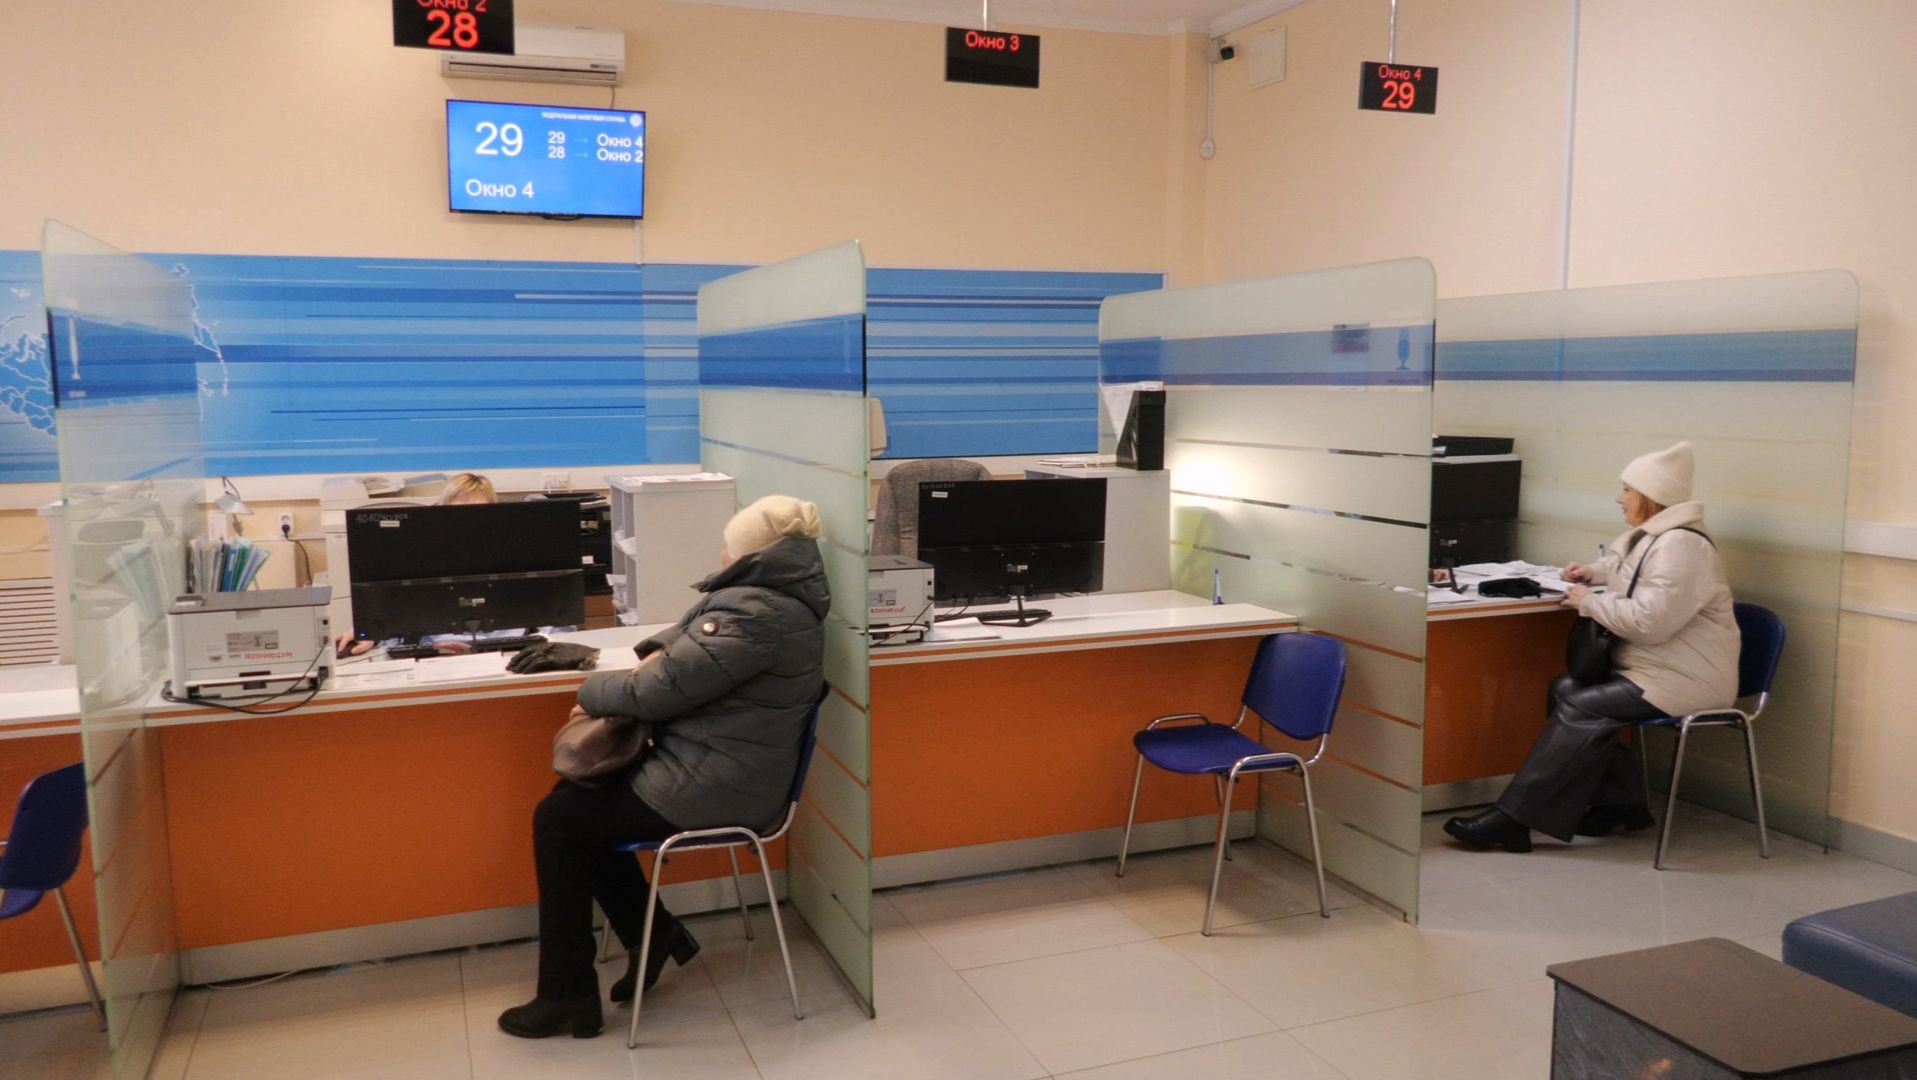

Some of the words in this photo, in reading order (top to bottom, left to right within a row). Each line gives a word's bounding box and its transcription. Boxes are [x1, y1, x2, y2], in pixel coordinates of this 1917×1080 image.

[427, 9, 479, 49] 28
[966, 31, 1006, 49] Окно
[1011, 34, 1020, 51] 3
[1378, 65, 1411, 80] Окно
[1414, 68, 1422, 81] 4
[1382, 81, 1415, 109] 29
[475, 121, 524, 157] 29
[548, 131, 566, 144] 29
[597, 133, 632, 147] Окно
[635, 136, 644, 148] 4
[548, 146, 566, 159] 28
[596, 148, 632, 162] Окно
[635, 150, 644, 163] 2
[466, 179, 518, 198] Окно
[522, 181, 535, 199] 4
